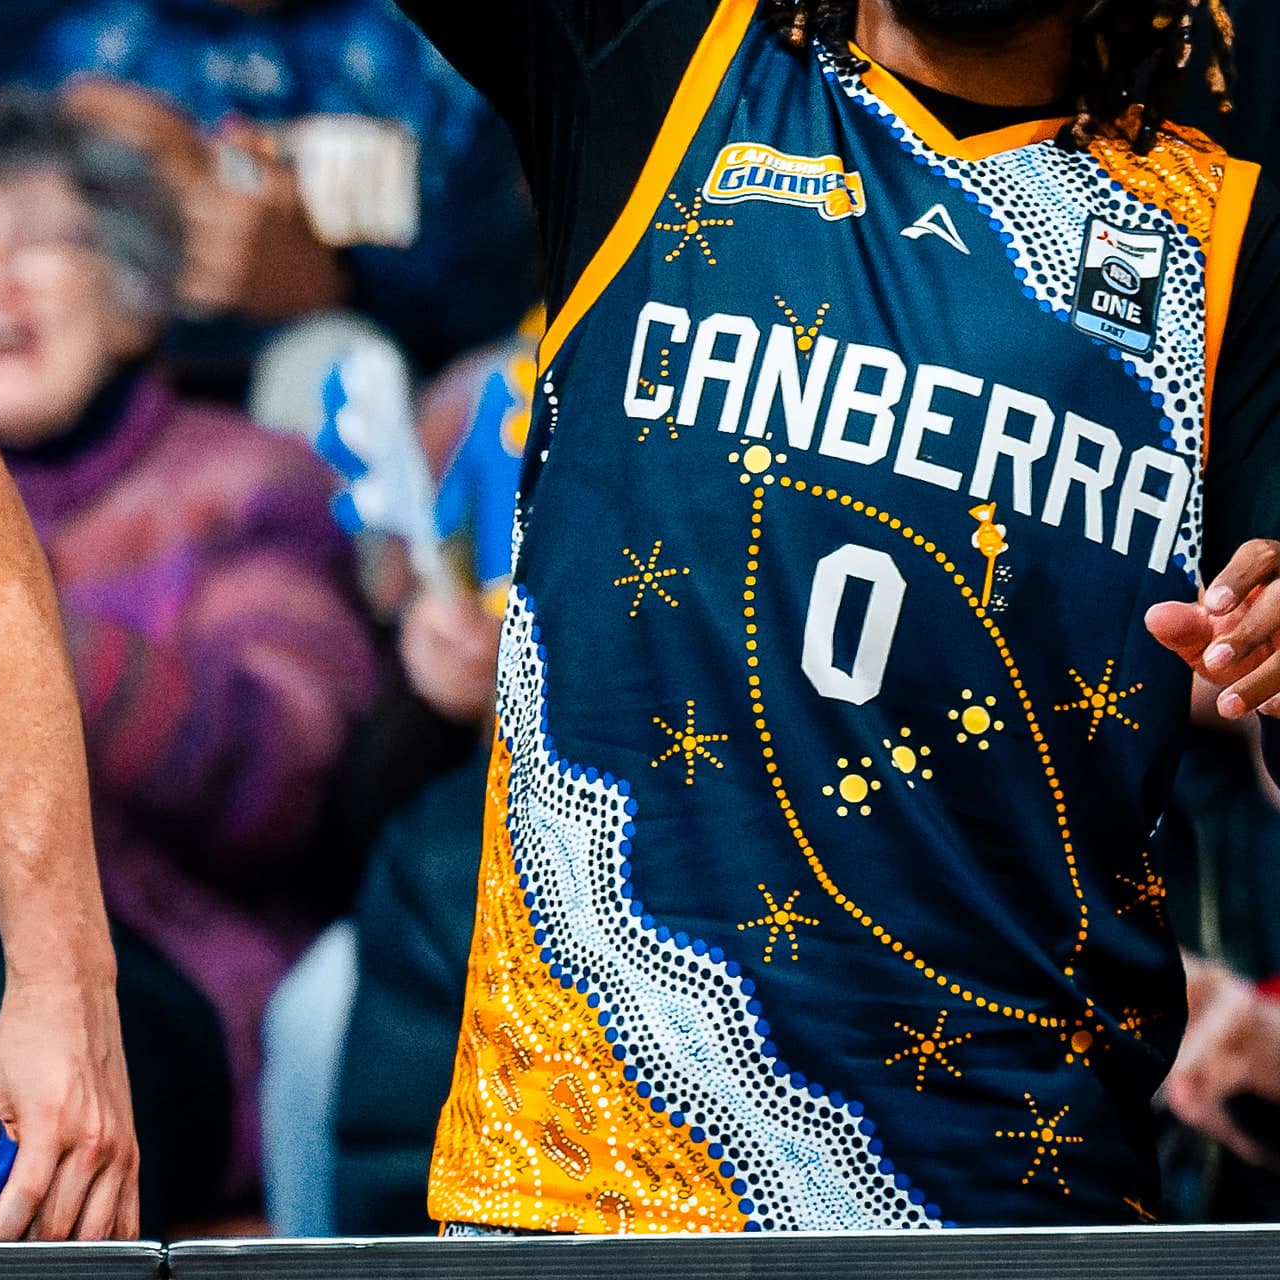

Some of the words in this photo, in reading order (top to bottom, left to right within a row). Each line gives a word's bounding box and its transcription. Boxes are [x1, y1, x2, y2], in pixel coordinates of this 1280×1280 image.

[1091, 290, 1143, 324] ONE
[622, 300, 1192, 574] CANBERRA
[801, 543, 907, 706] 0
